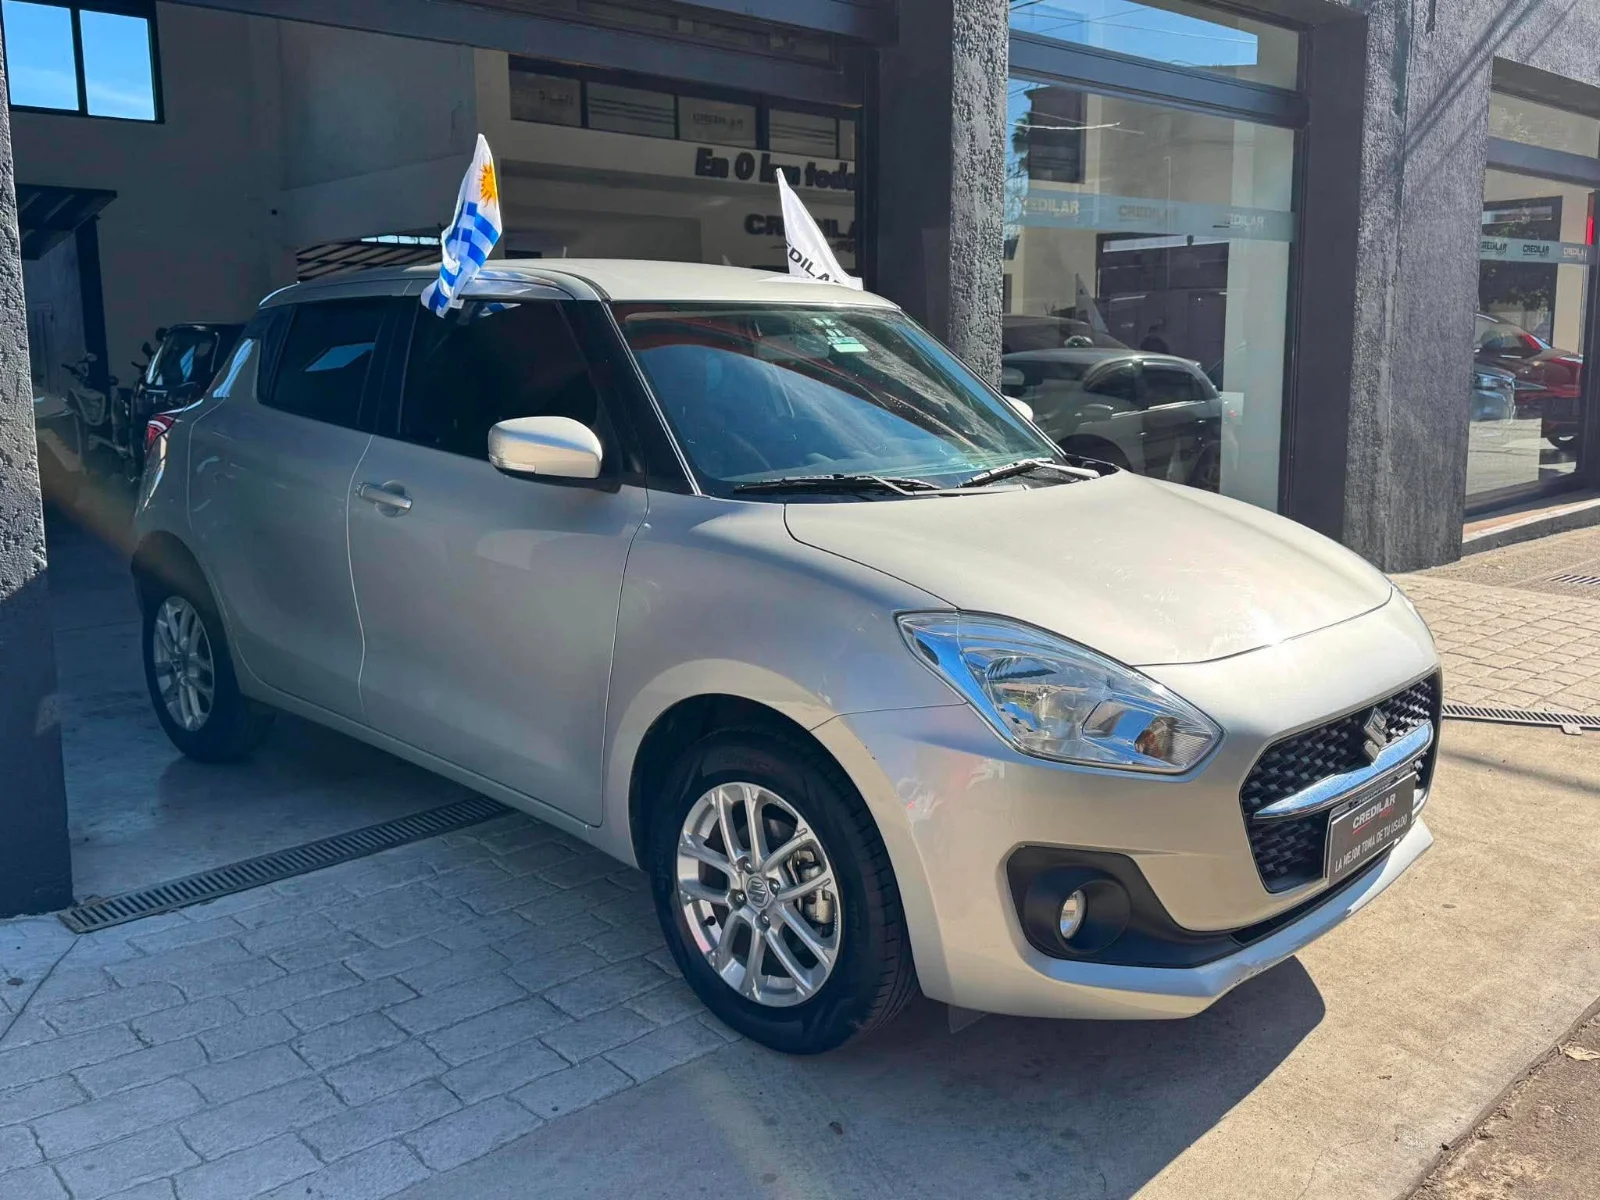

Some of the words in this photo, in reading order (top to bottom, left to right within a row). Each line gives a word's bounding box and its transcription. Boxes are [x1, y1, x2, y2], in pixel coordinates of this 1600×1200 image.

[694, 147, 729, 179] En
[786, 242, 841, 284] DILA
[1523, 244, 1549, 253] CREDILAR
[1352, 793, 1396, 829] CREDILAR
[1335, 857, 1343, 873] LA
[1343, 844, 1361, 865] MEJOR
[1376, 830, 1384, 843] DE
[1383, 824, 1391, 838] TU
[1391, 813, 1408, 834] USADO
